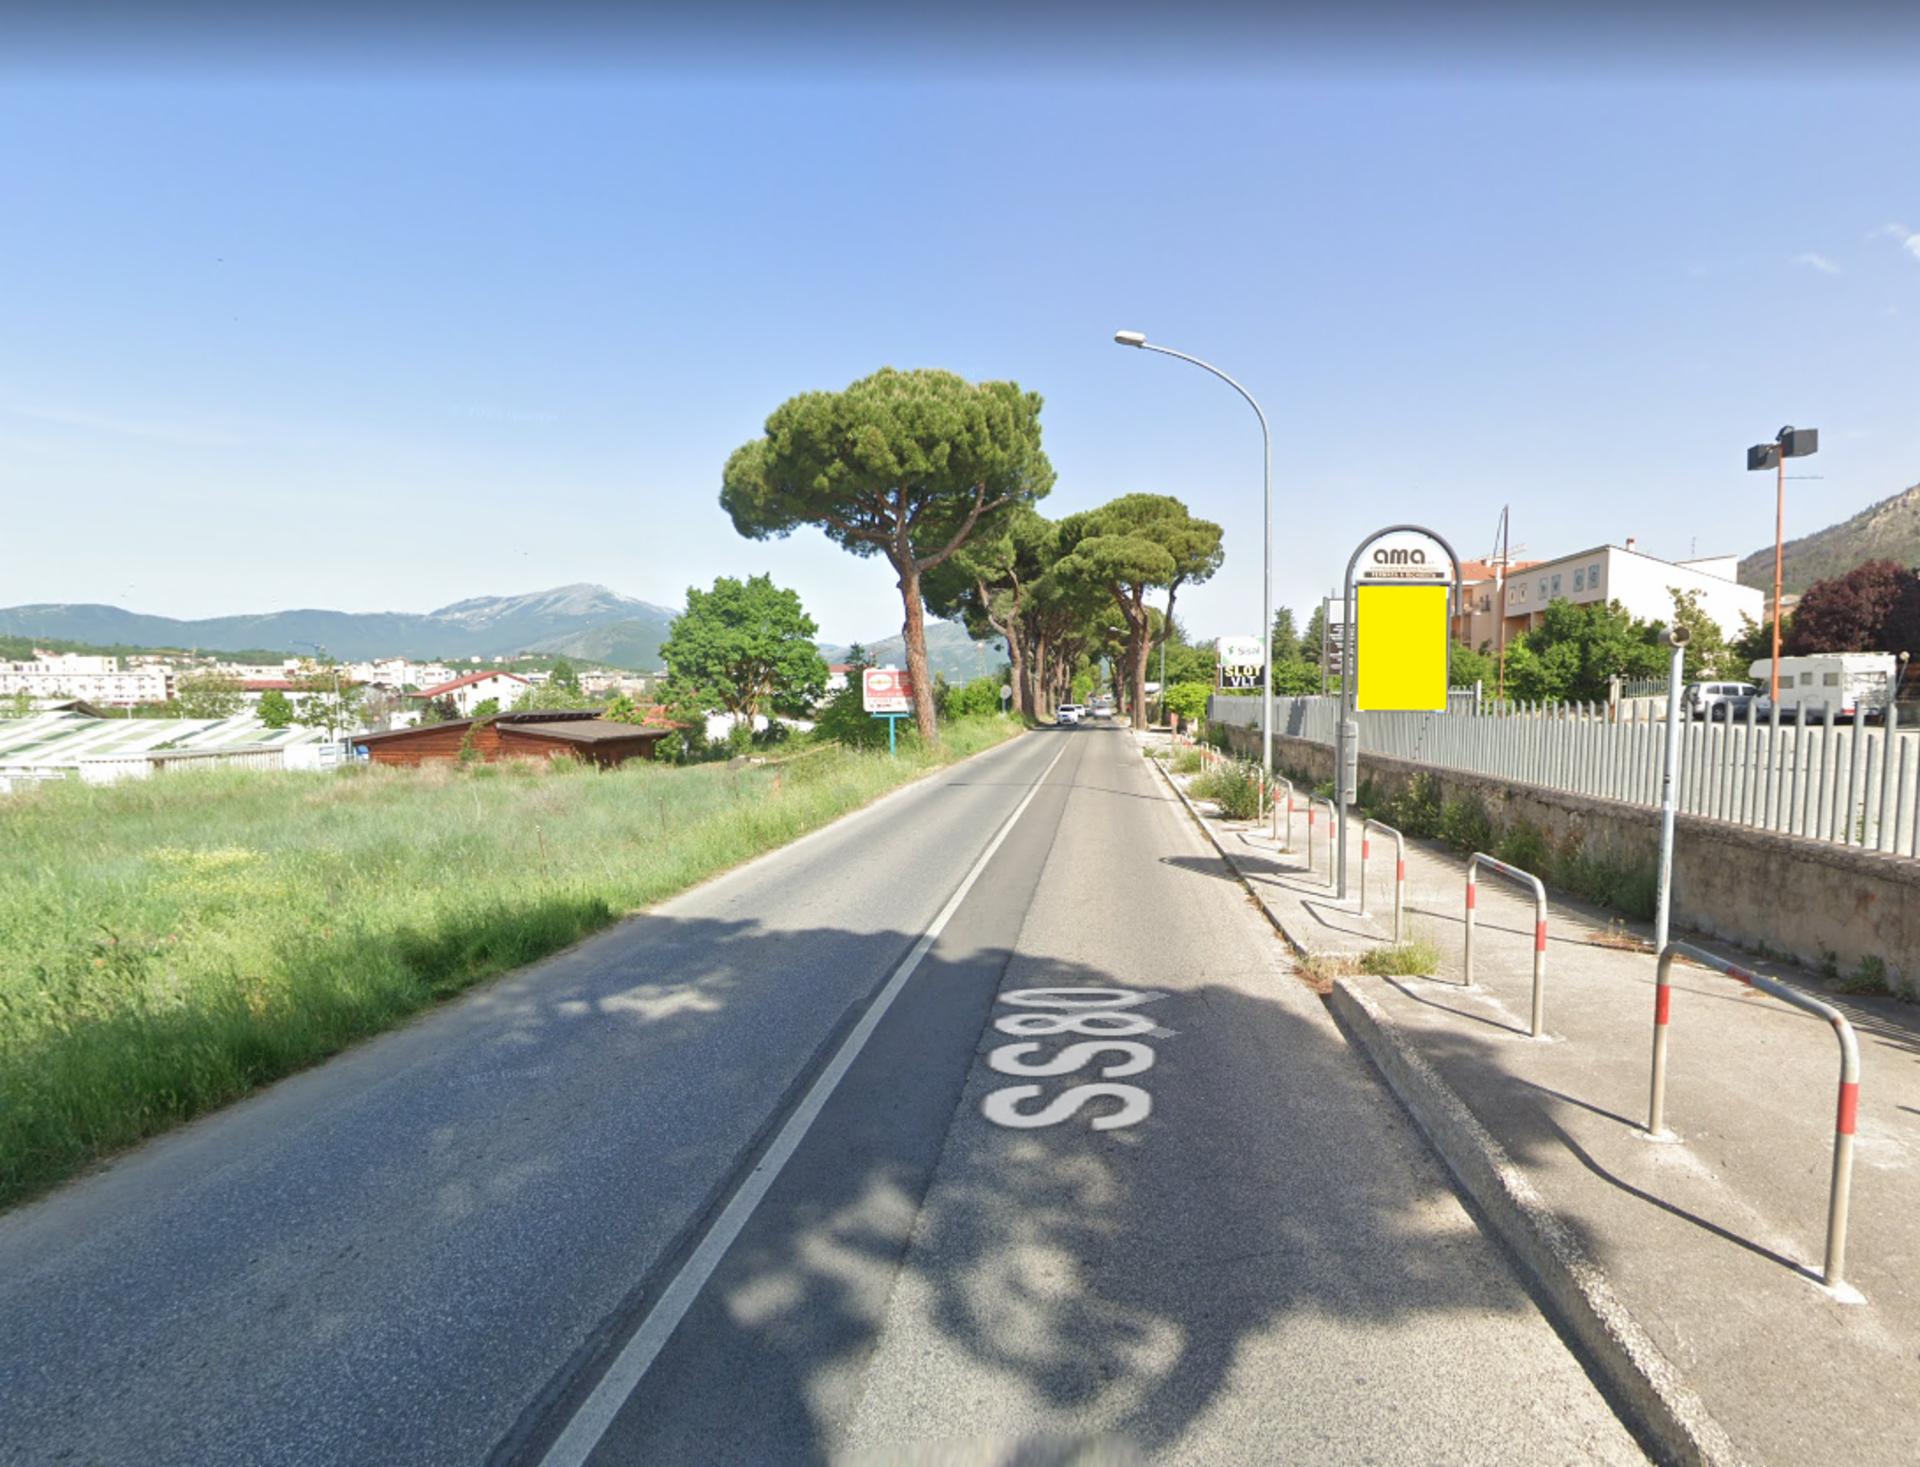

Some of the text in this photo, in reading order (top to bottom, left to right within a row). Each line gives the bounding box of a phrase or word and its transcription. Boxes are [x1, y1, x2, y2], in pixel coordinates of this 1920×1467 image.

[1373, 548, 1426, 565] ama
[1224, 665, 1262, 677] SLOT
[1230, 676, 1256, 687] VLT
[982, 987, 1157, 1131] SS80
